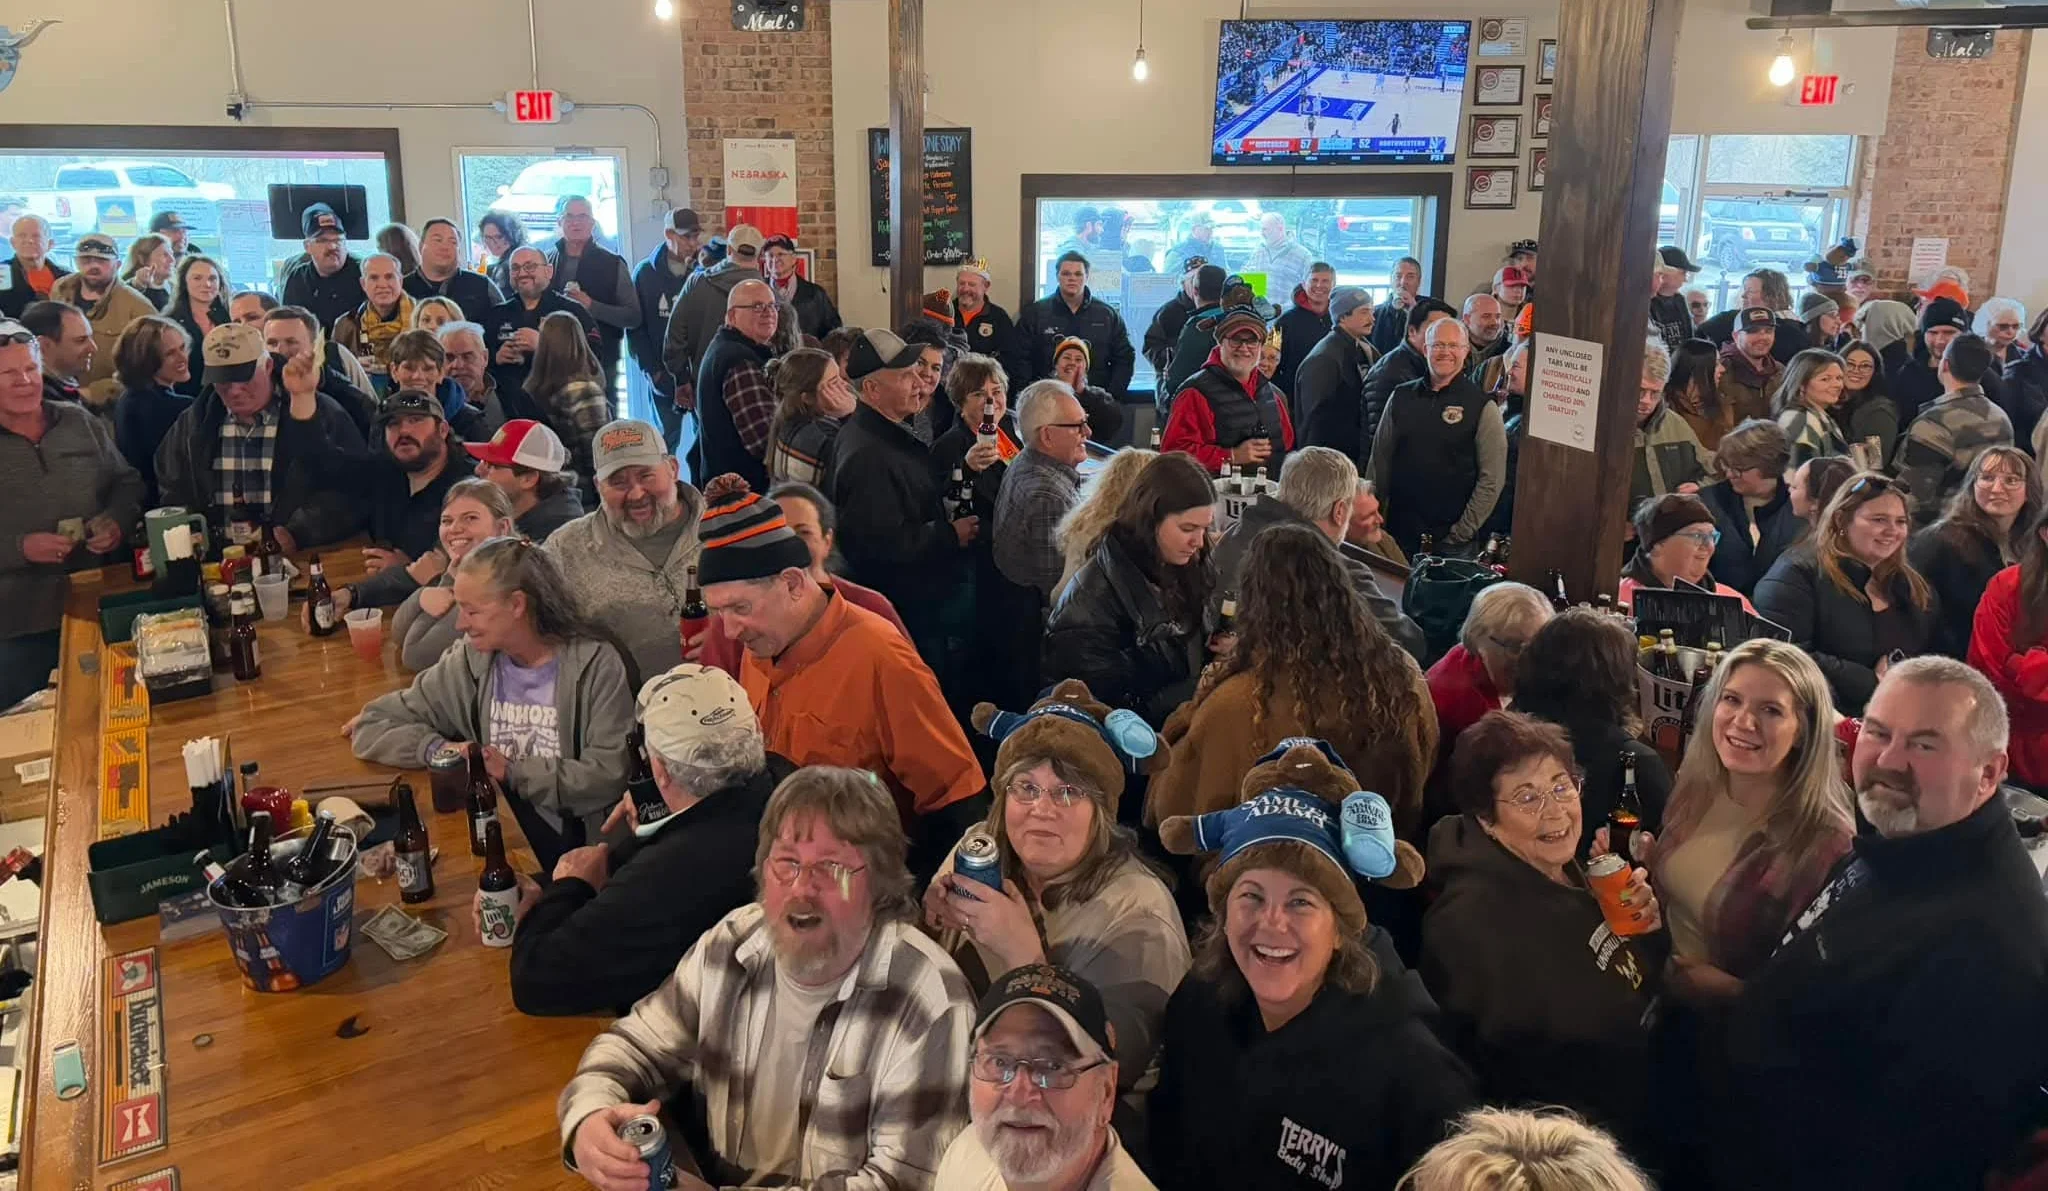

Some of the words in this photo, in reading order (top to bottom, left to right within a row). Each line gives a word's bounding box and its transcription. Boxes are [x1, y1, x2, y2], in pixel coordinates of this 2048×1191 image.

[742, 11, 795, 31] Mal's
[1936, 40, 1983, 57] Mals
[1801, 75, 1839, 104] EXIT
[515, 91, 553, 121] EXIT
[1360, 139, 1371, 149] 52
[731, 170, 788, 179] NEBRASKA
[1548, 357, 1564, 367] TABS
[1564, 361, 1579, 371] WILL
[1559, 349, 1592, 360] UNCLOSED
[1542, 368, 1592, 384] AUTOMATICALLY
[1541, 379, 1576, 393] PROCESSED
[1576, 387, 1591, 397] AND
[1543, 391, 1572, 405] CHARGED
[1572, 398, 1586, 408] 20%
[1547, 404, 1579, 417] GRATUITY
[1653, 681, 1688, 713] Lit
[1241, 794, 1331, 823] SAMUEL
[1245, 804, 1326, 829] ADAMS
[140, 874, 190, 895] JAMESON
[129, 997, 157, 1090] Budweiser
[1277, 1145, 1306, 1175] Body
[1280, 1116, 1346, 1186] TERRY'S
